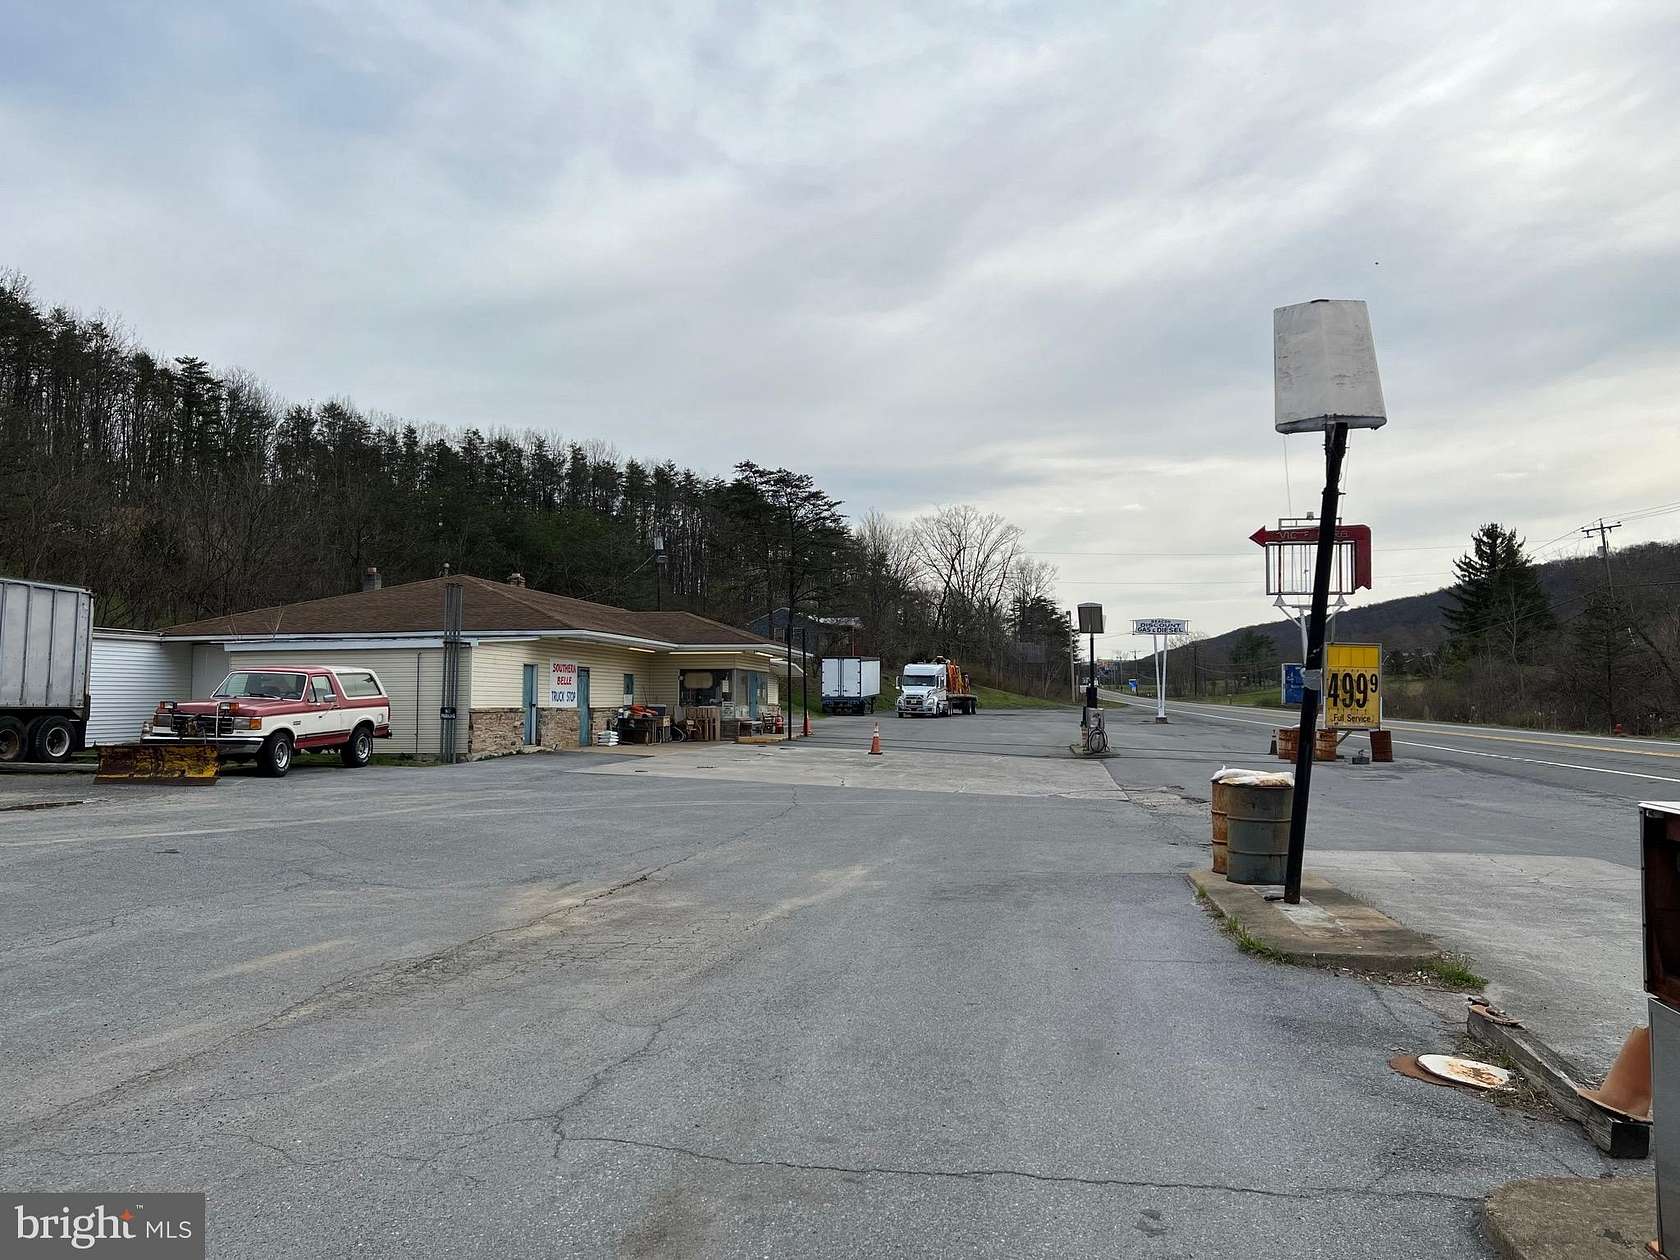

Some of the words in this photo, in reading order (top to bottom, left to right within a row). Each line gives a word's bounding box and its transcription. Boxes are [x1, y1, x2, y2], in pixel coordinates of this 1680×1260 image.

[552, 663, 576, 673] SOUTHERN
[556, 676, 572, 685] BELLE
[551, 691, 564, 702] TRUCK
[566, 691, 576, 702] STOP
[1333, 714, 1344, 722] Full
[1346, 714, 1371, 722] Service
